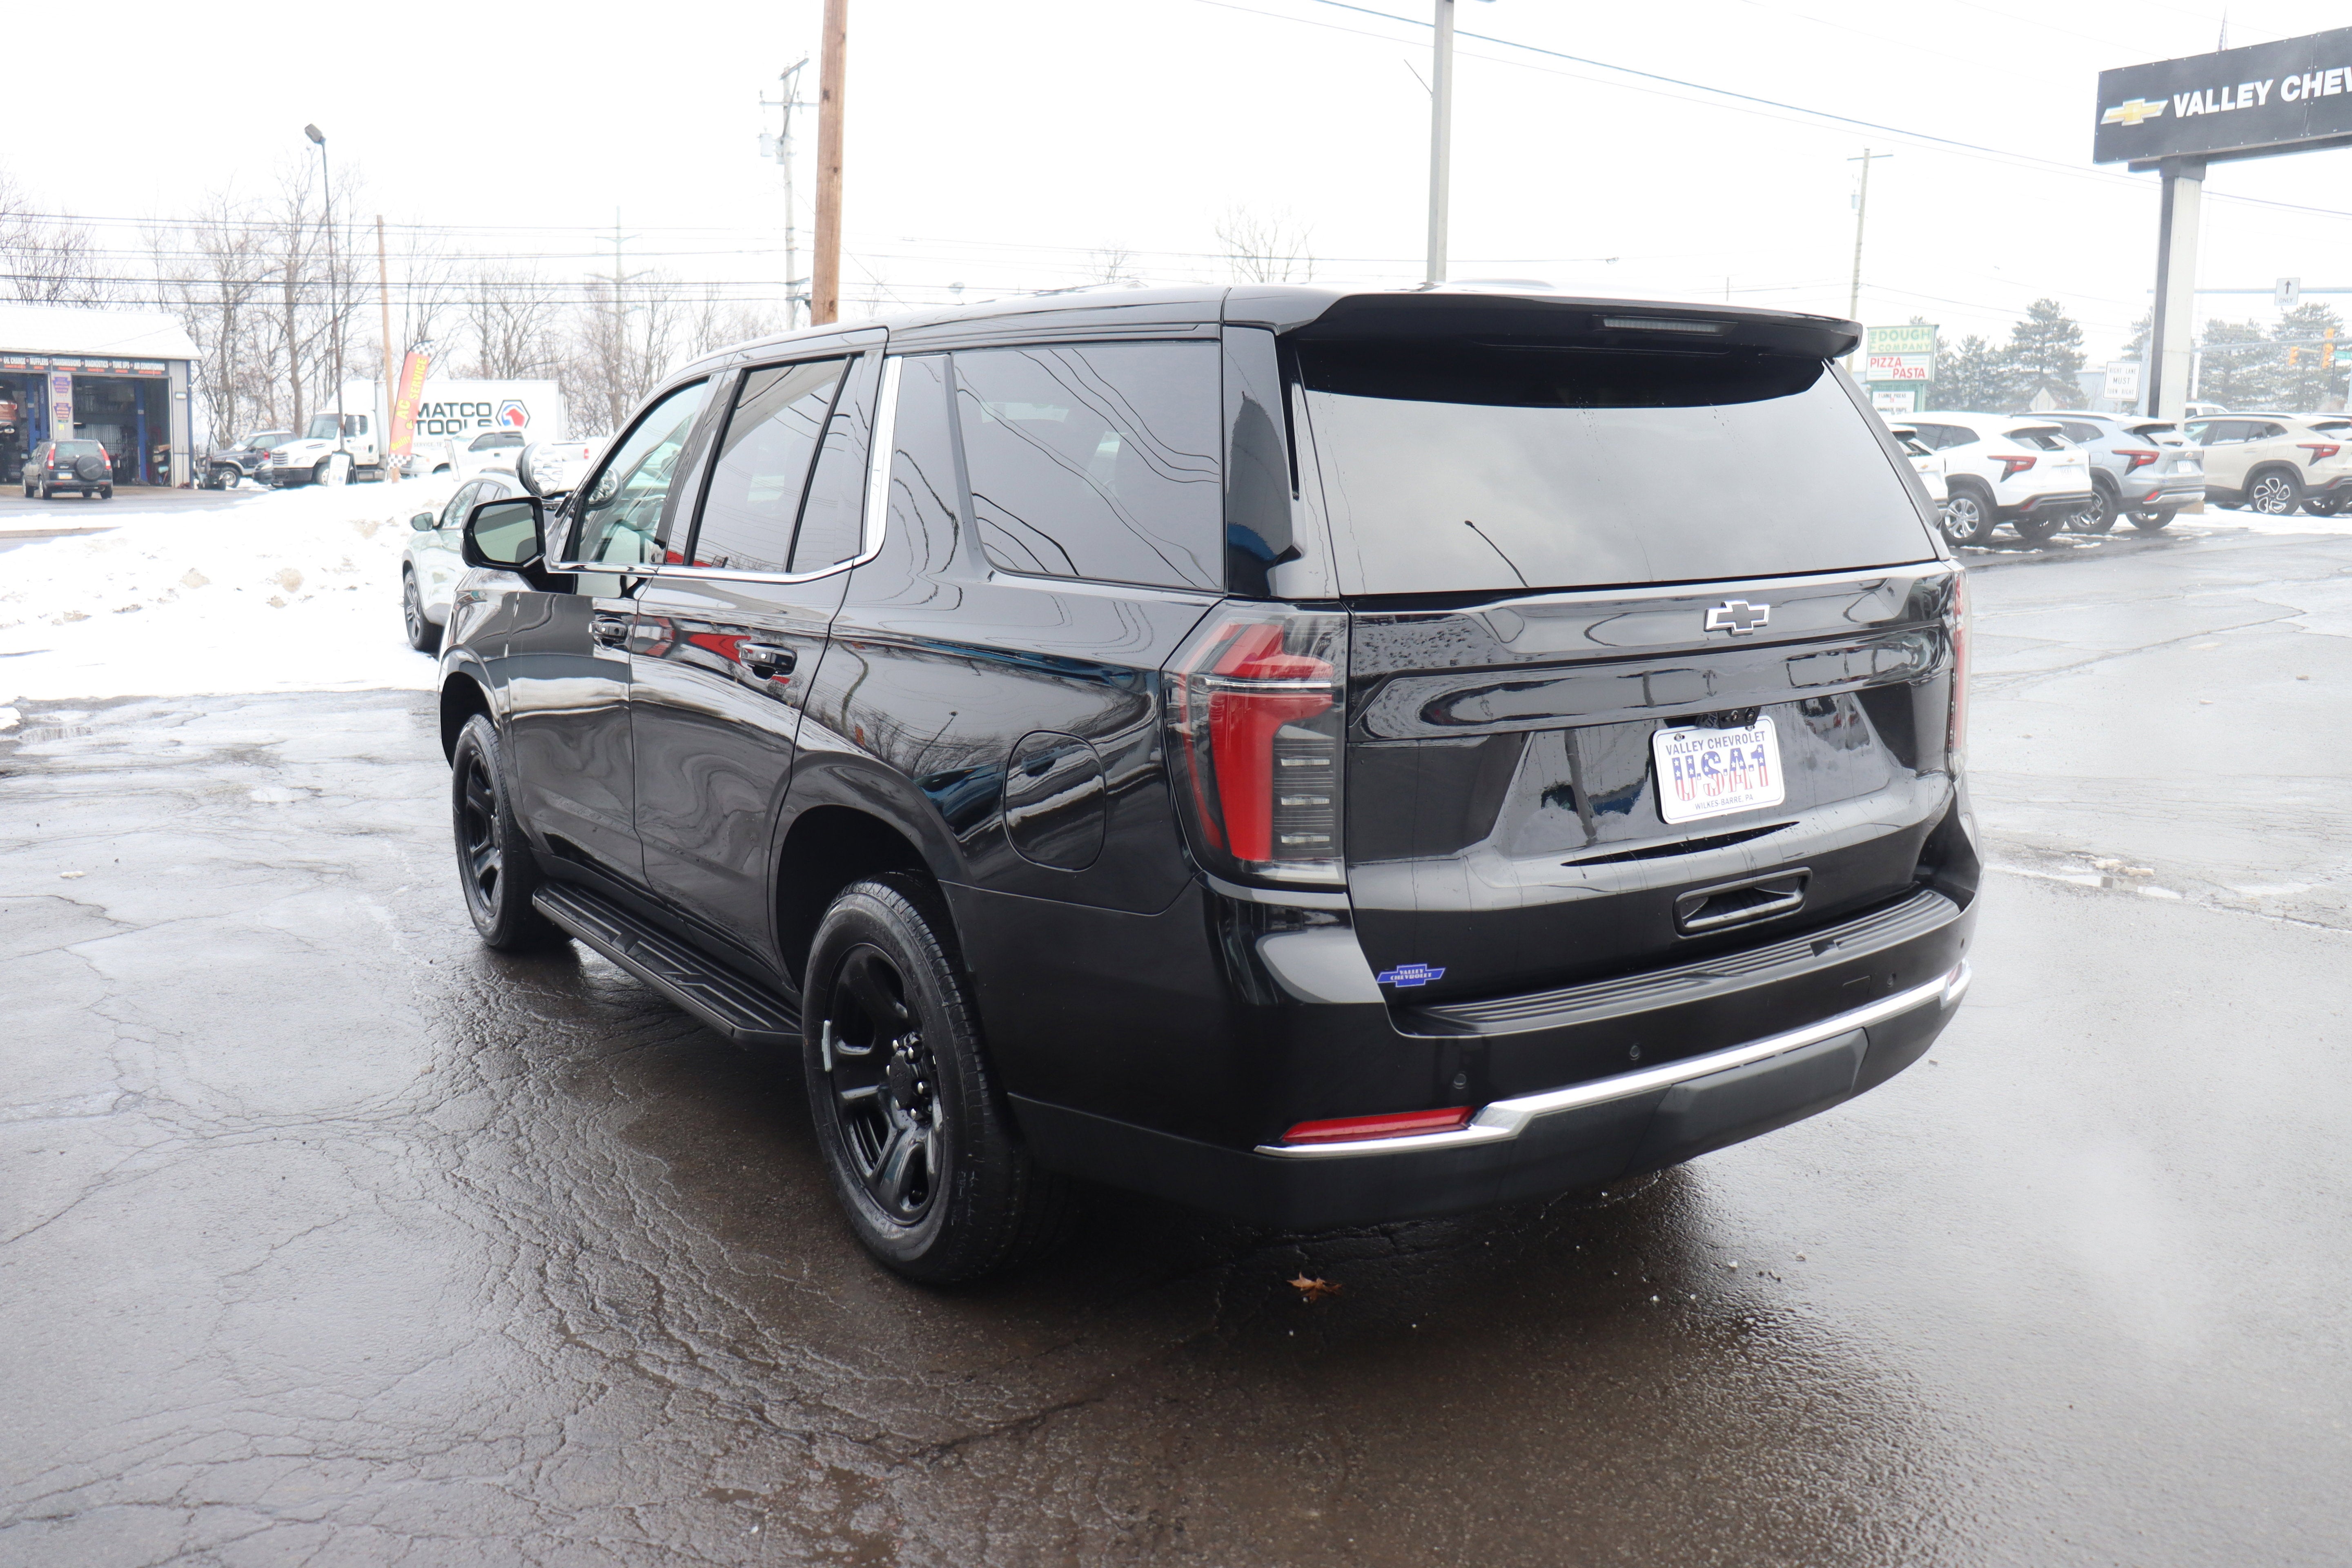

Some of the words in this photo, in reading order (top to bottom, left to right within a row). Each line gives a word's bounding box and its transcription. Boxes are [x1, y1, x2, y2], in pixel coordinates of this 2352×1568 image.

[2173, 79, 2274, 118] VALLEY
[1880, 329, 1931, 341] DOUGH
[1878, 343, 1930, 352] COMPANY
[30, 357, 49, 365] MUFFLERS
[52, 358, 81, 367] TRANSMISSIONS
[85, 360, 109, 368] DIAGNOSTICS
[140, 363, 165, 371] CONDITIONING
[1870, 357, 1902, 368] PIZZA
[409, 357, 428, 400] SERVICE
[1893, 368, 1925, 379] PASTA
[396, 399, 411, 420] AC
[418, 402, 492, 418] MATCO
[391, 435, 412, 451] Quality
[1666, 740, 1703, 755] VALLEY
[1708, 731, 1765, 749] CHEVROLET
[1695, 796, 1744, 810] WILKES-BARRE,
